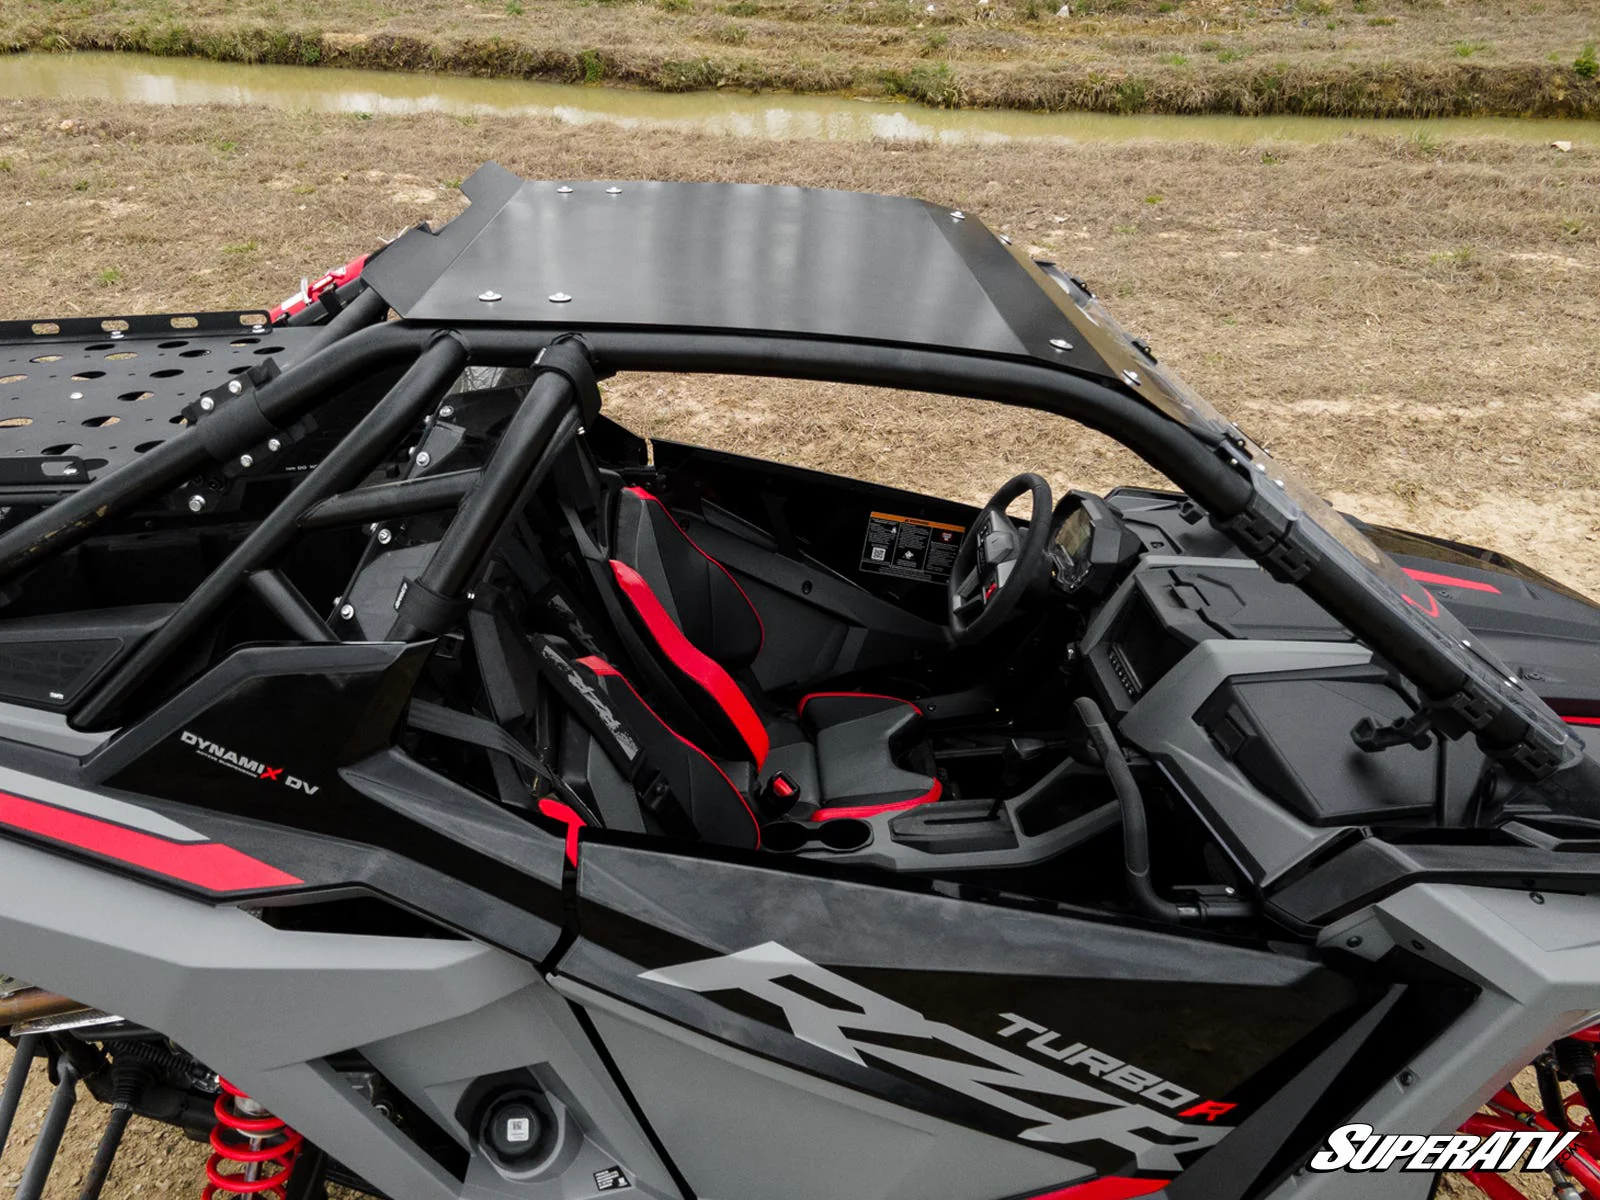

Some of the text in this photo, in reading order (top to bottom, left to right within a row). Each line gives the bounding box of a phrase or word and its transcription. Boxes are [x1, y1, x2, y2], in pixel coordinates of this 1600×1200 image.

[180, 730, 320, 795] DYNAMIX DV
[638, 941, 1235, 1172] RZR
